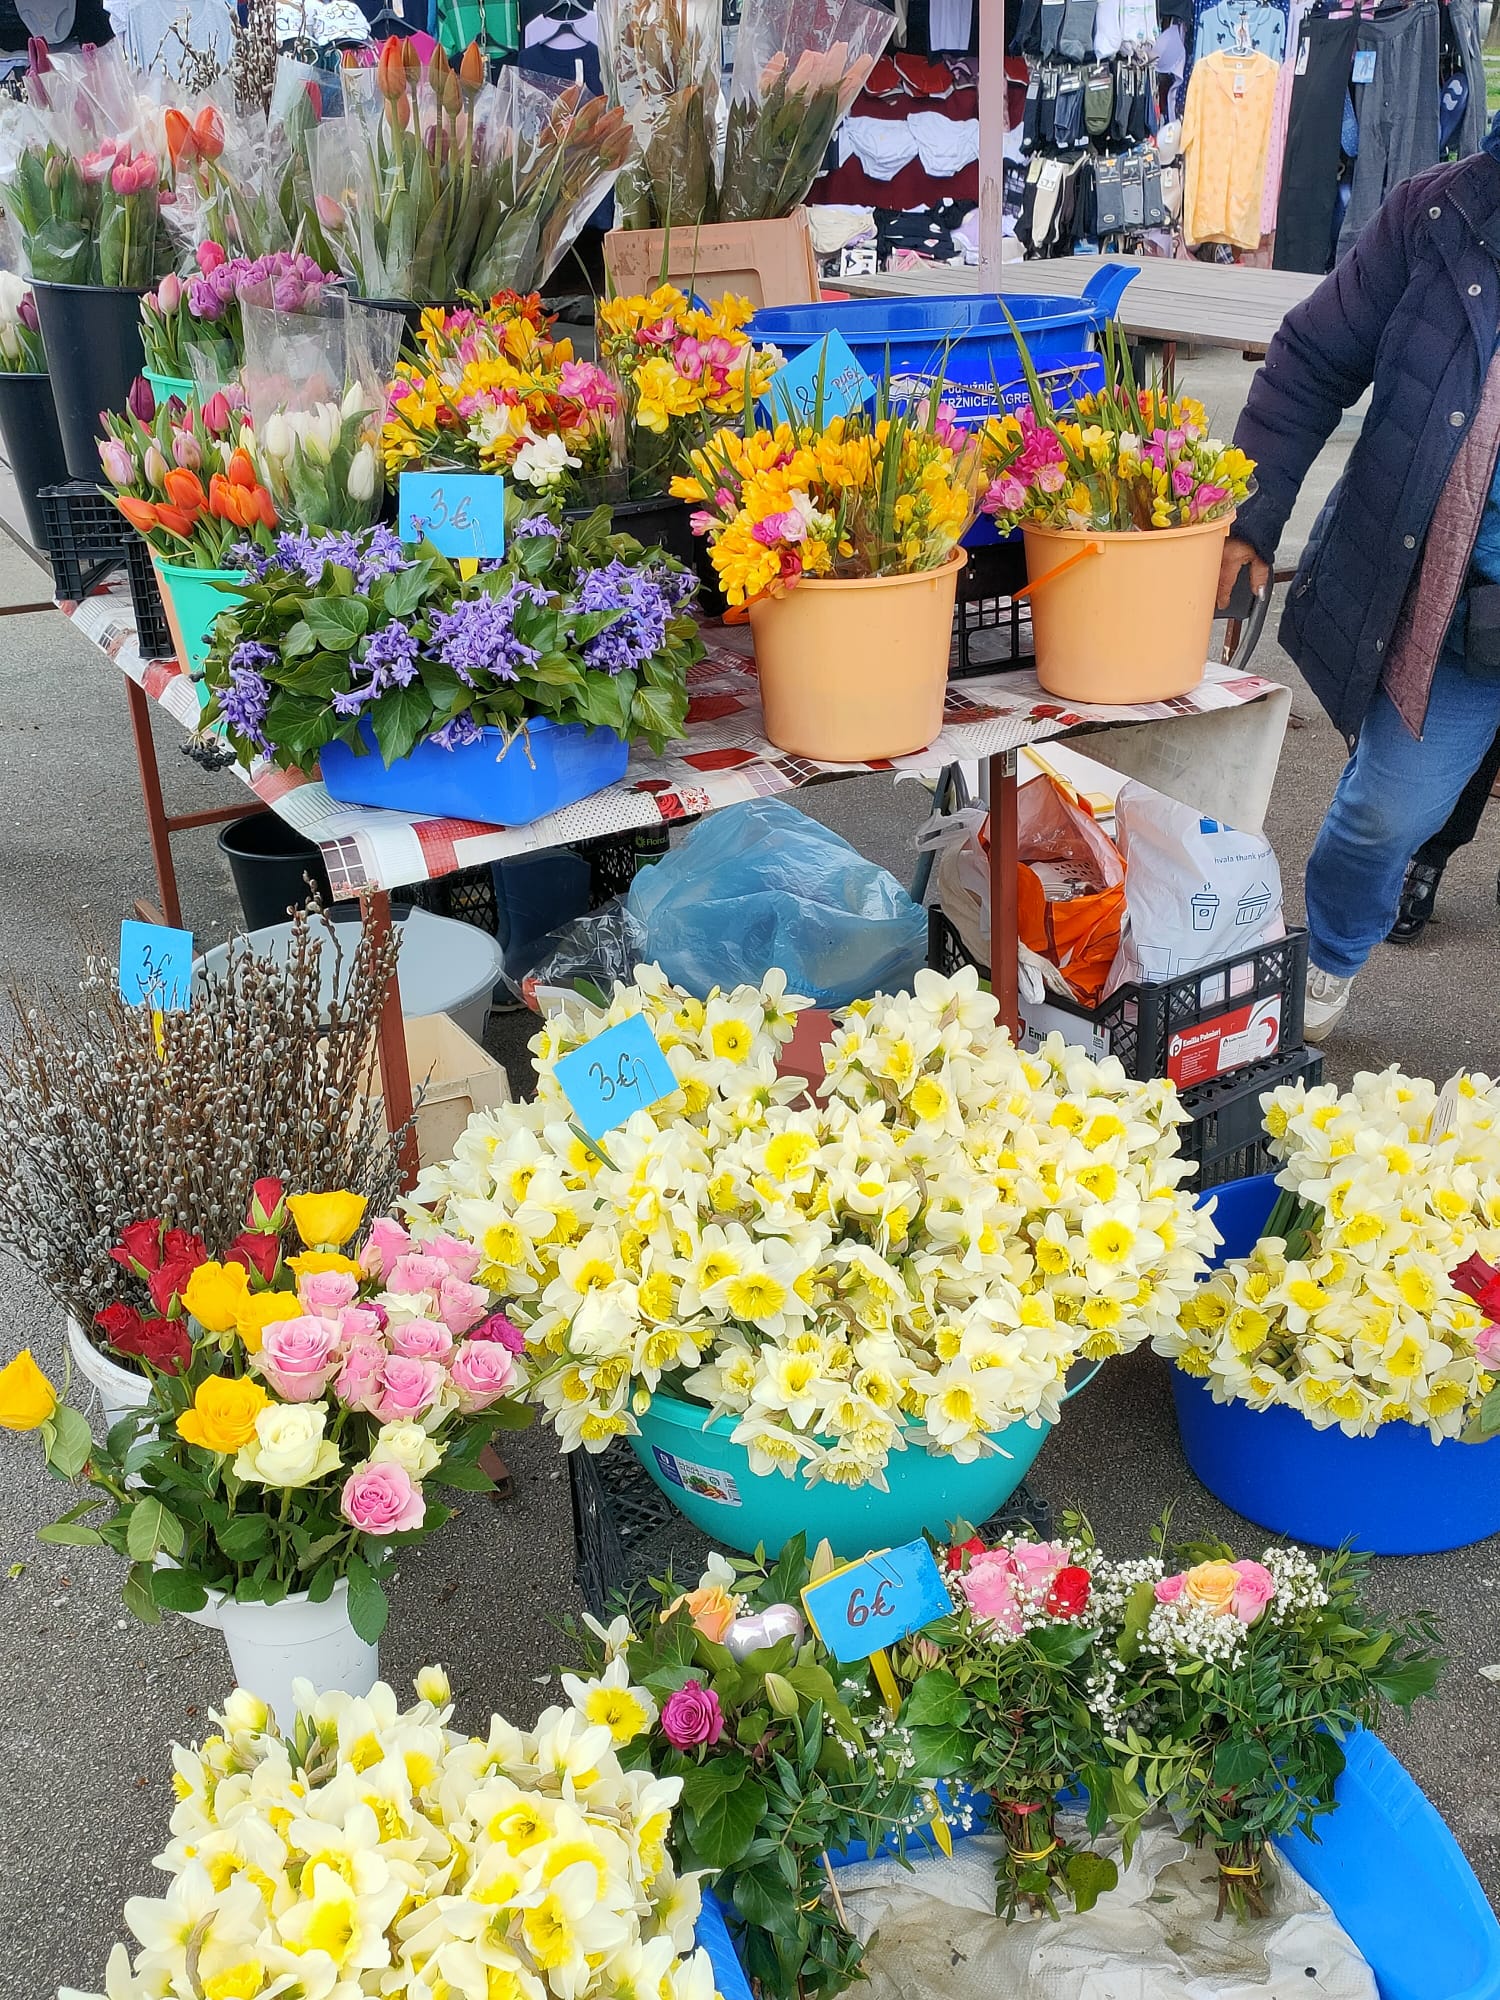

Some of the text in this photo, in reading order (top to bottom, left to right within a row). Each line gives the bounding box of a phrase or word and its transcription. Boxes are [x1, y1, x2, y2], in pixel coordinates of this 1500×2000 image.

[941, 391, 1033, 408] TRŽNICE ZAGRE
[428, 487, 472, 530] 3€
[1214, 855, 1234, 865] hvala
[1235, 852, 1257, 862] thank
[588, 1053, 638, 1101] 3€
[847, 1580, 896, 1627] 6€
